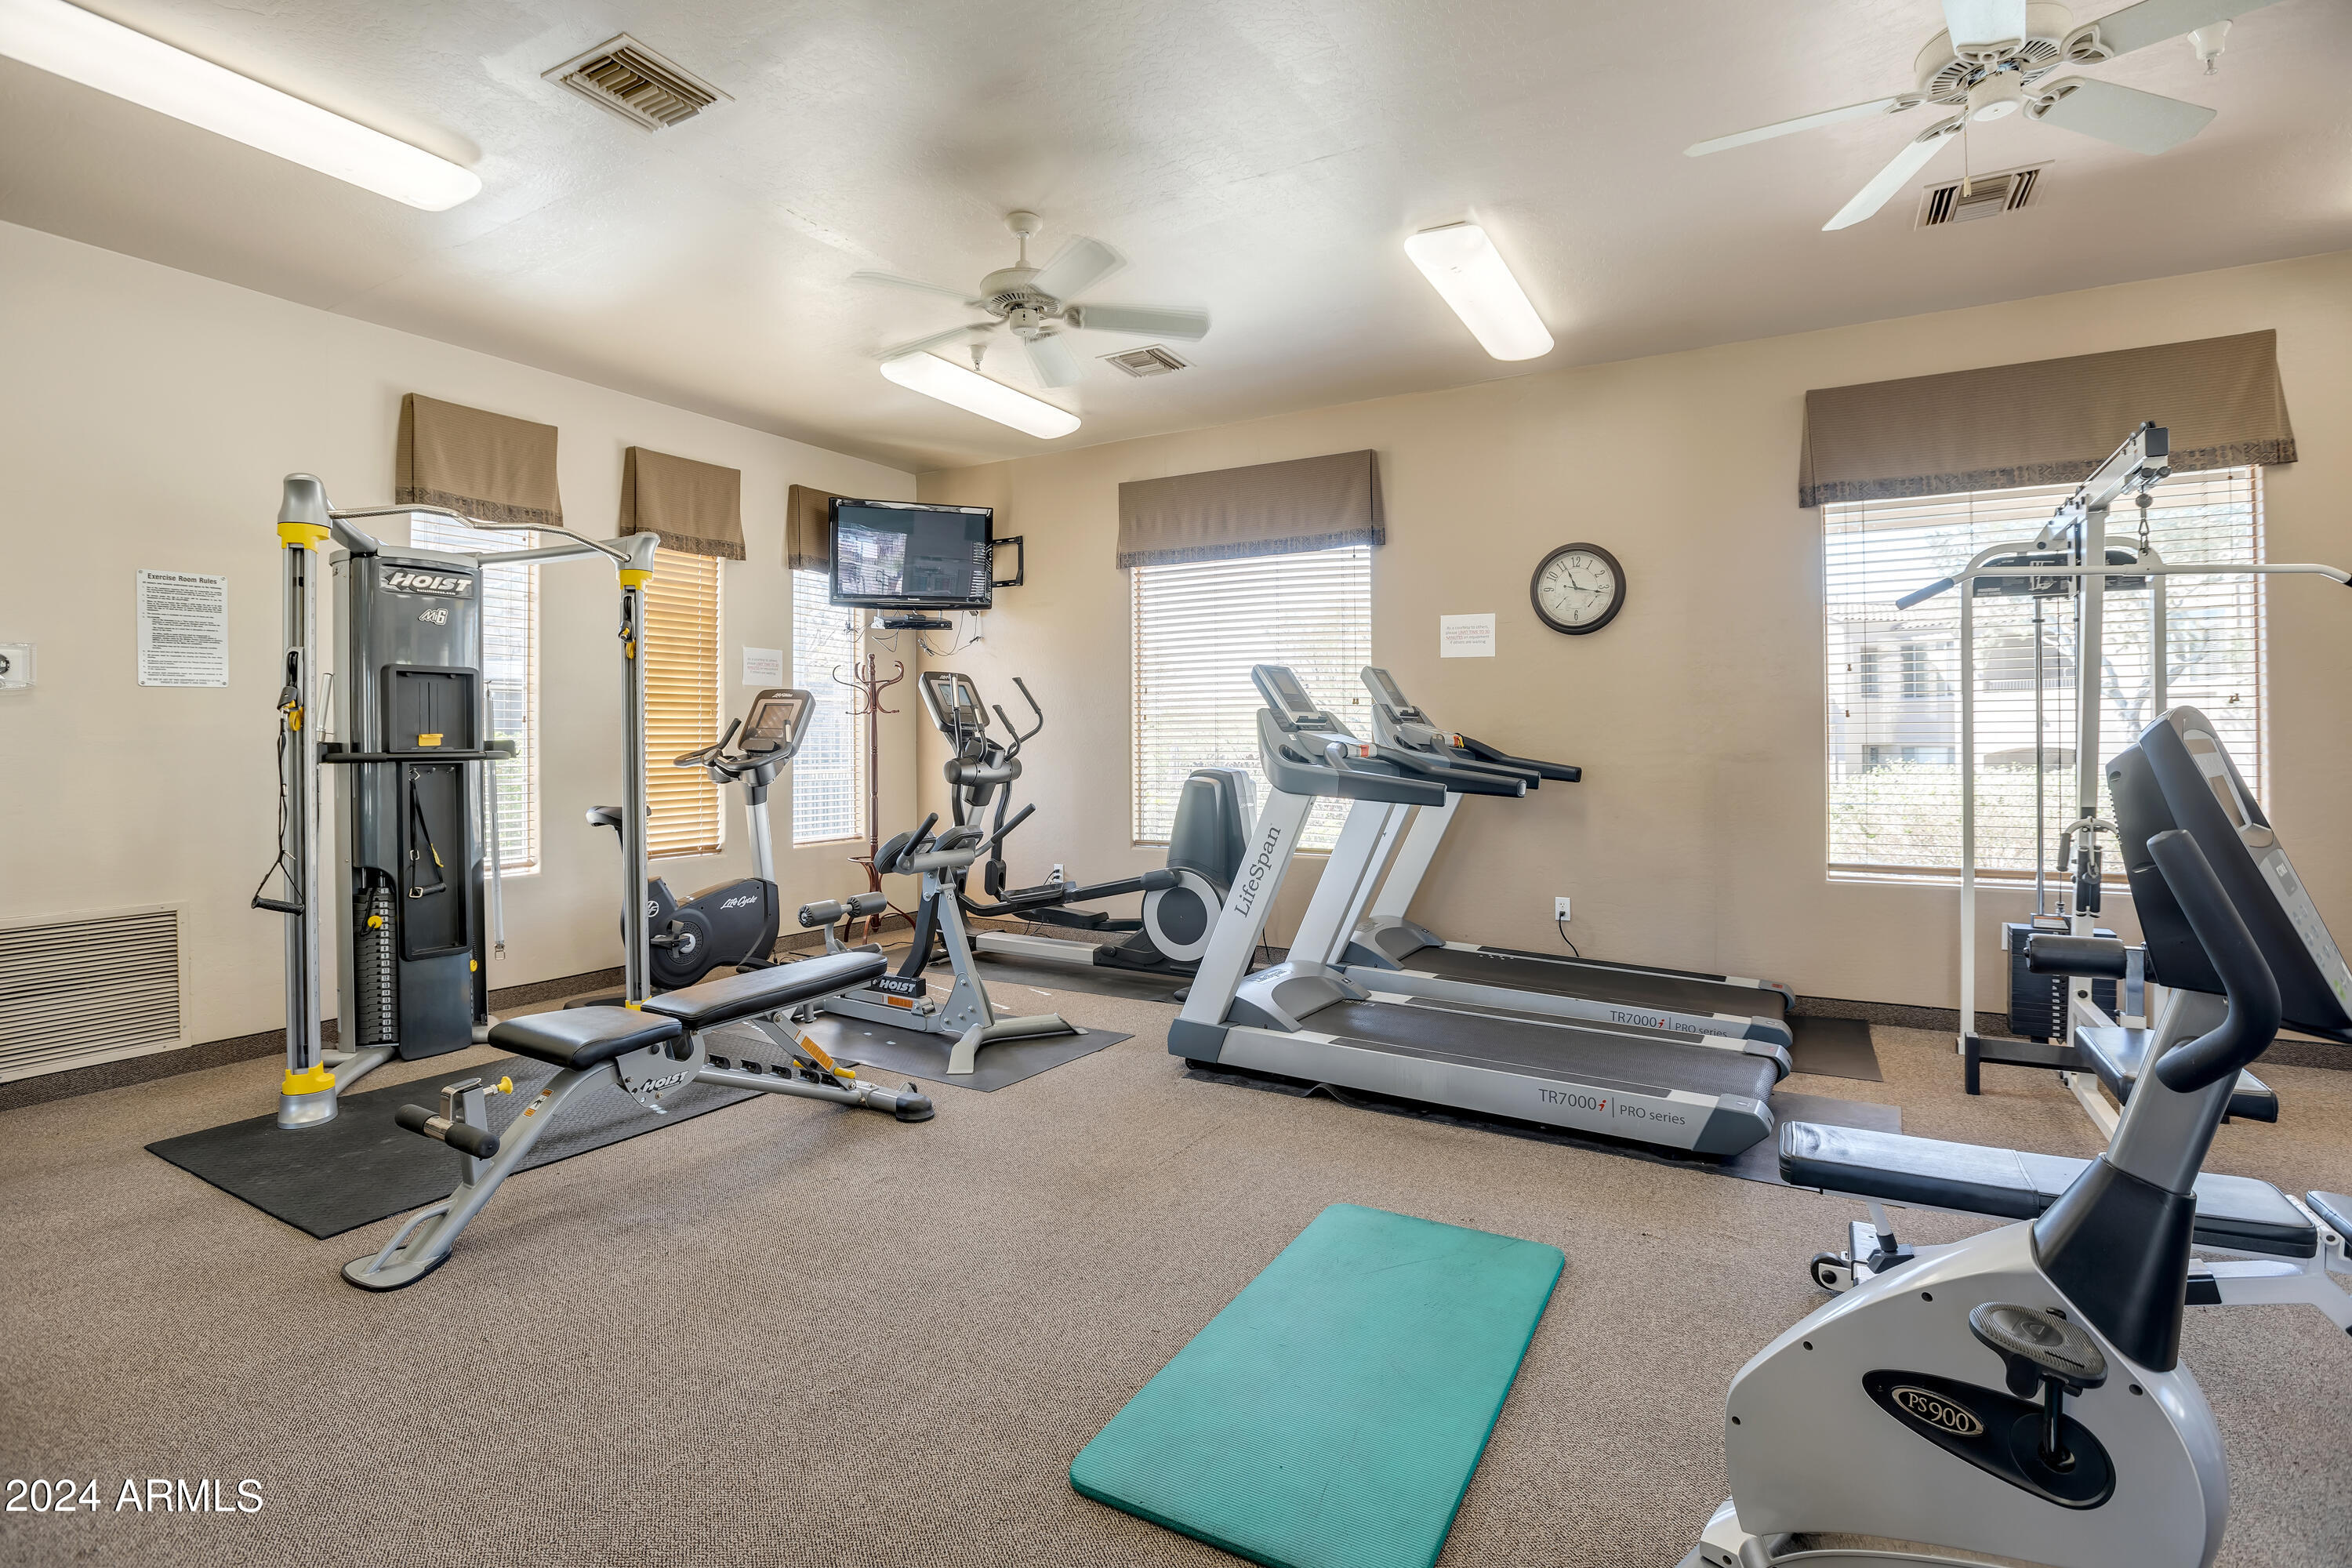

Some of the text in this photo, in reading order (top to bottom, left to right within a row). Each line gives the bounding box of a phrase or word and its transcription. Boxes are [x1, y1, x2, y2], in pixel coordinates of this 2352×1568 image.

[1557, 561, 1567, 572] 11
[1572, 557, 1581, 567] 12
[1587, 560, 1592, 570] 1
[147, 572, 176, 581] Exercise
[389, 572, 472, 591] HOIST
[1547, 571, 1558, 582] 10
[1574, 610, 1578, 621] 6
[1234, 826, 1281, 918] LifeSpan
[879, 979, 916, 993] HOIST
[1610, 1011, 1727, 1037] TR7000i PRO series
[642, 1070, 689, 1092] HOIST
[1538, 1088, 1686, 1125] TR7000i PRO series
[1908, 1392, 1969, 1432] PS900
